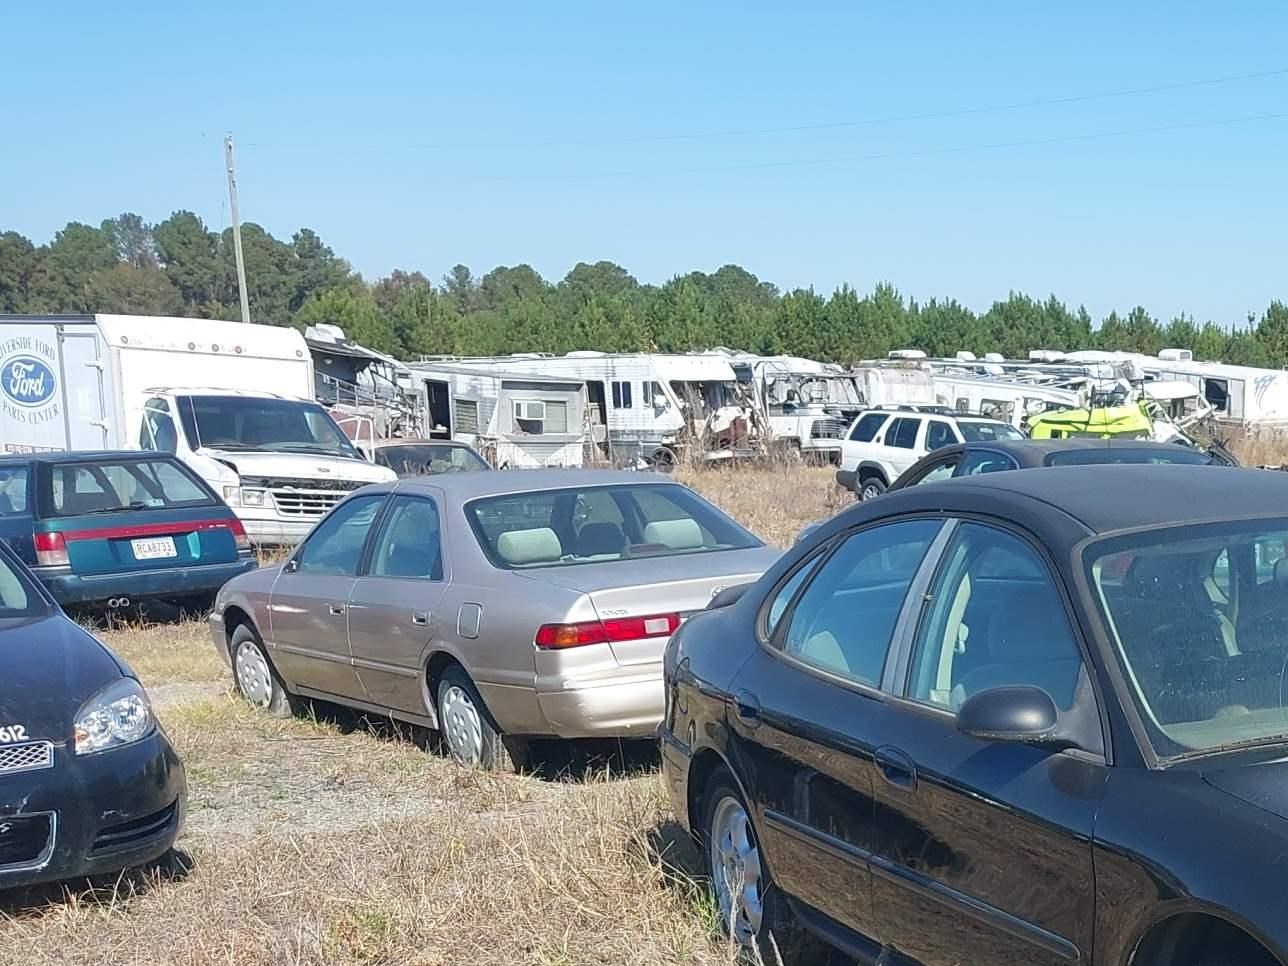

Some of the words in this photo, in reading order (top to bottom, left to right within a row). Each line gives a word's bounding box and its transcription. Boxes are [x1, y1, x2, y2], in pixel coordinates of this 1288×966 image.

[0, 336, 33, 359] IVERSIDE
[35, 338, 56, 361] FORD
[10, 361, 46, 396] Ford
[3, 400, 26, 423] PARTS
[28, 403, 59, 425] CENTER
